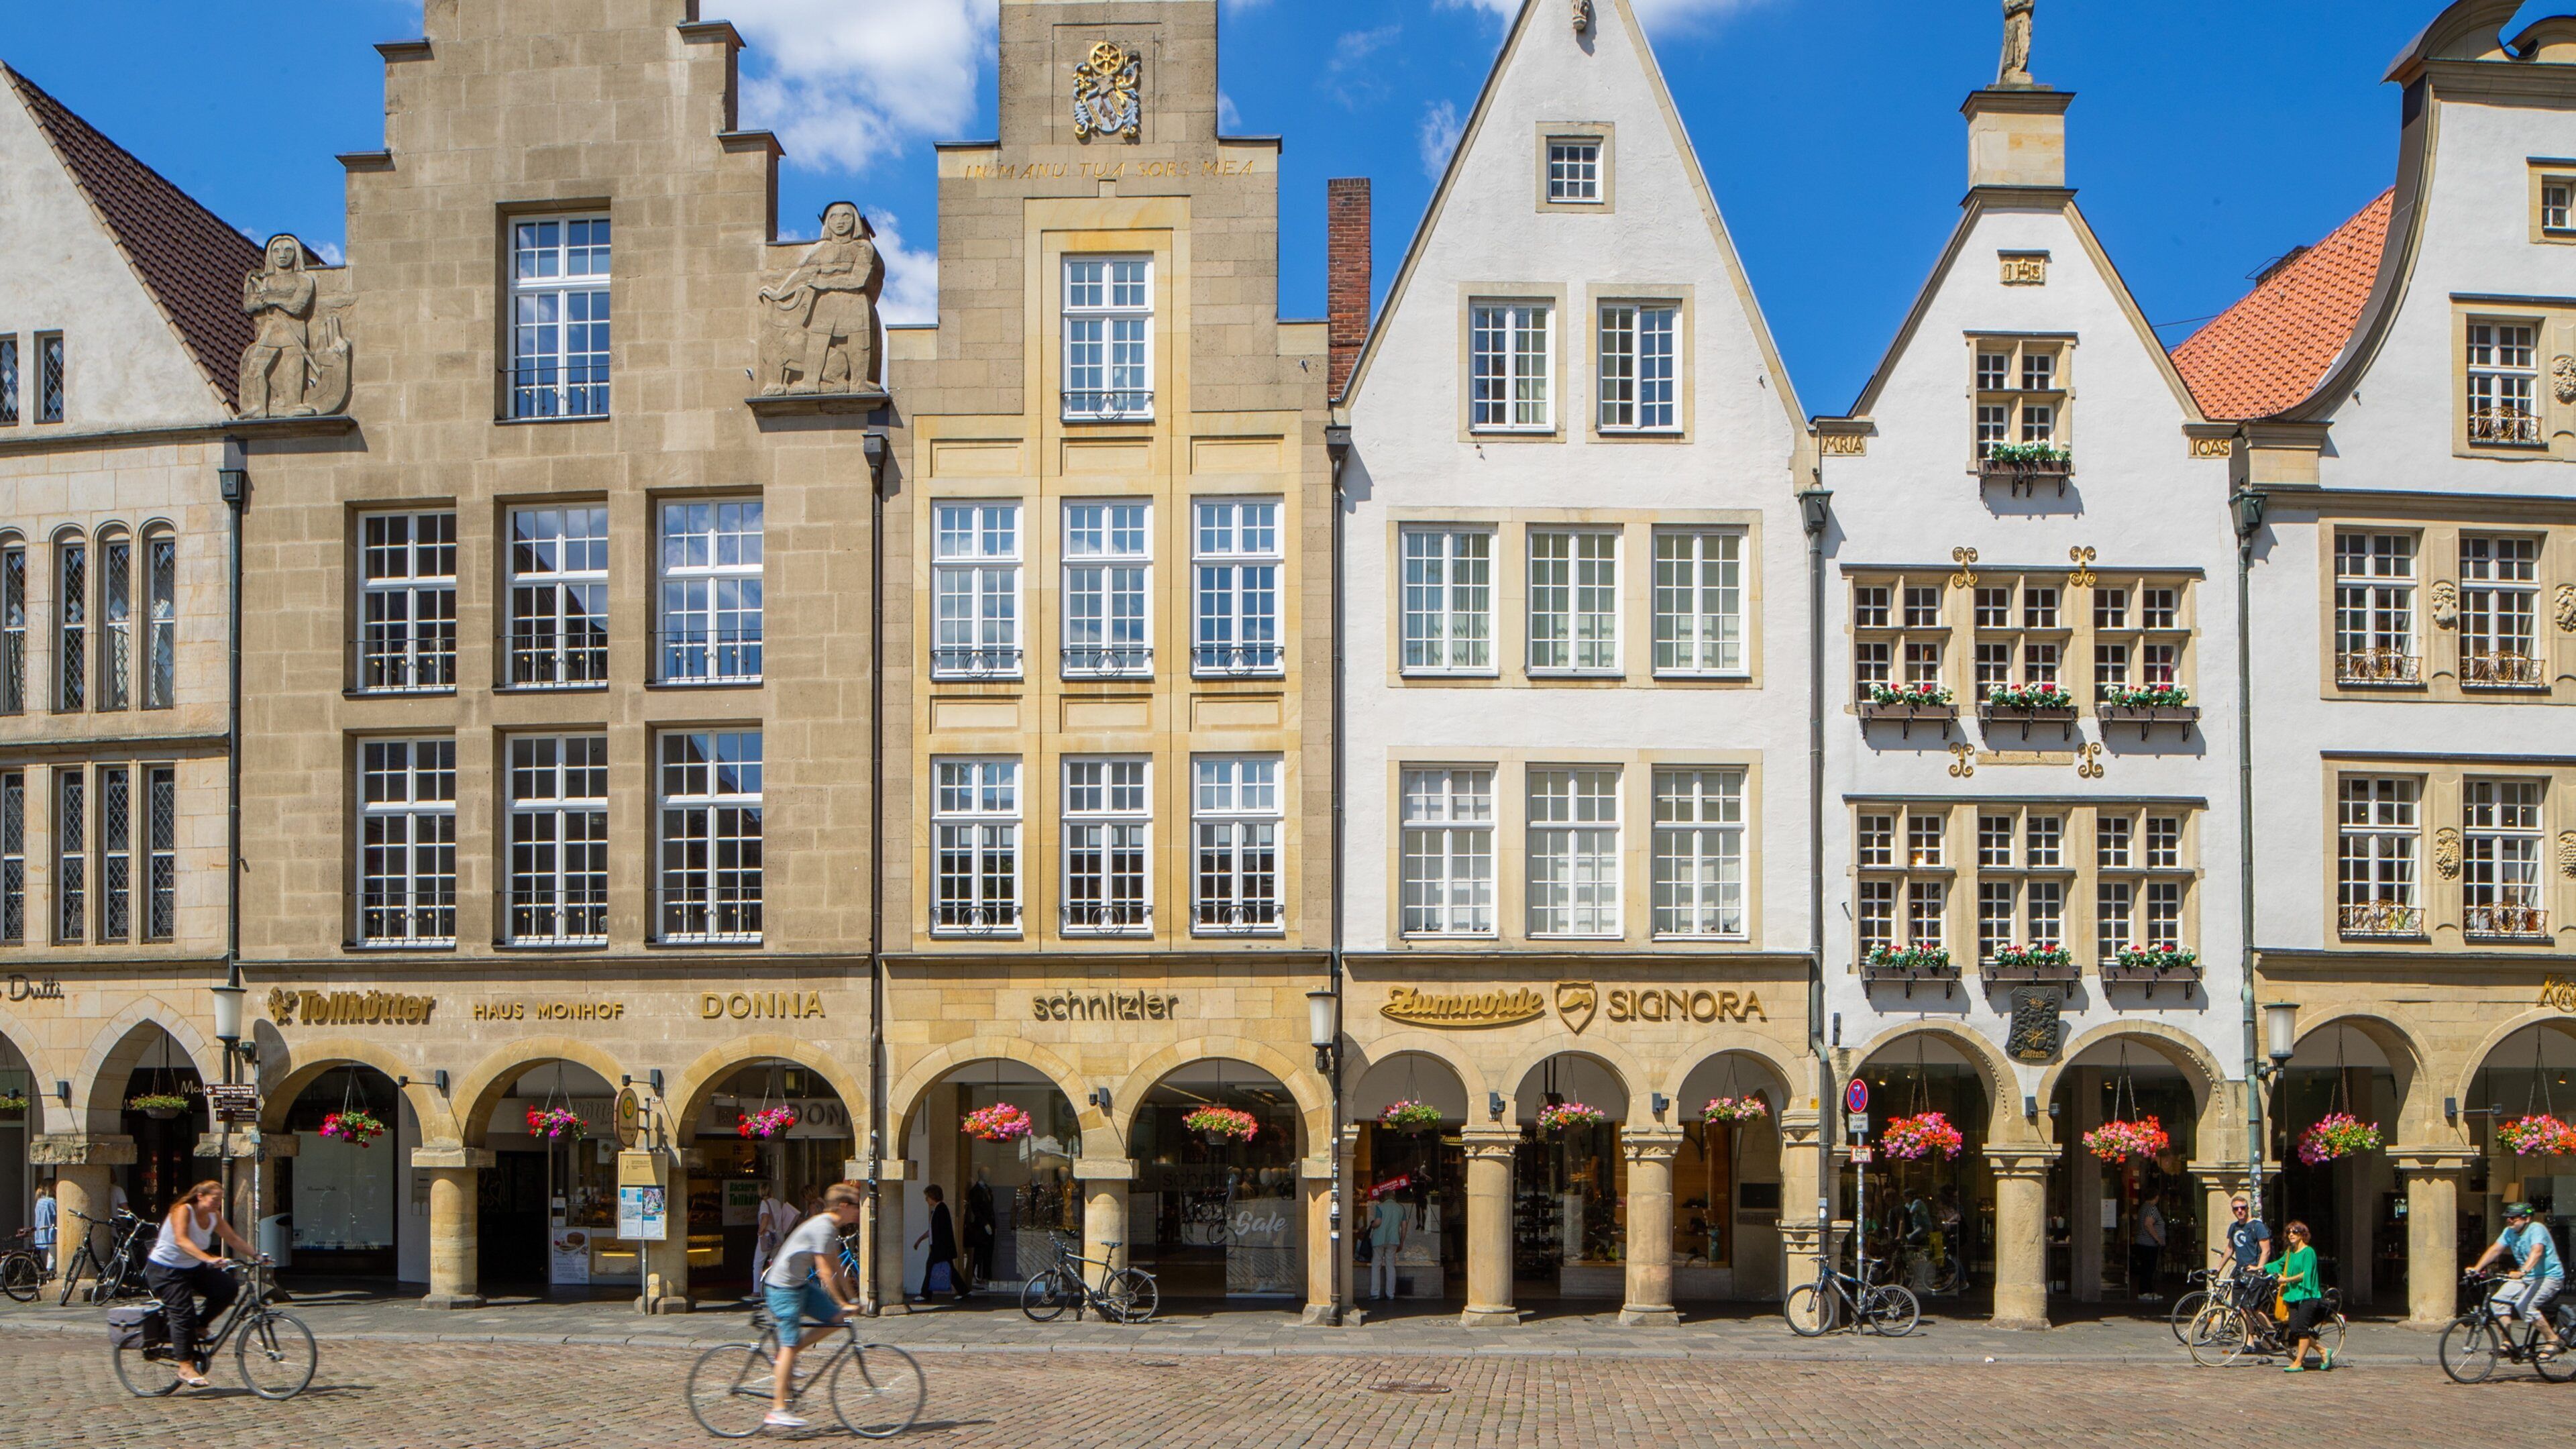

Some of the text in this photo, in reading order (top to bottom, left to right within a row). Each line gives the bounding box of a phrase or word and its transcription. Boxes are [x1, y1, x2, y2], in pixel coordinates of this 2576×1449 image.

[965, 160, 1254, 180] IN MANU TUA SORS MEA
[7, 973, 65, 1002] Dutti
[298, 989, 437, 1024] Tollkötter
[474, 1001, 625, 1020] HAUS MONHOF
[700, 991, 826, 1019] DONNA
[1032, 987, 1179, 1021] schnitzler
[1379, 985, 1547, 1028] Zumnorde
[1607, 988, 1768, 1023] SIGNORA
[1234, 1210, 1287, 1236] Sale
